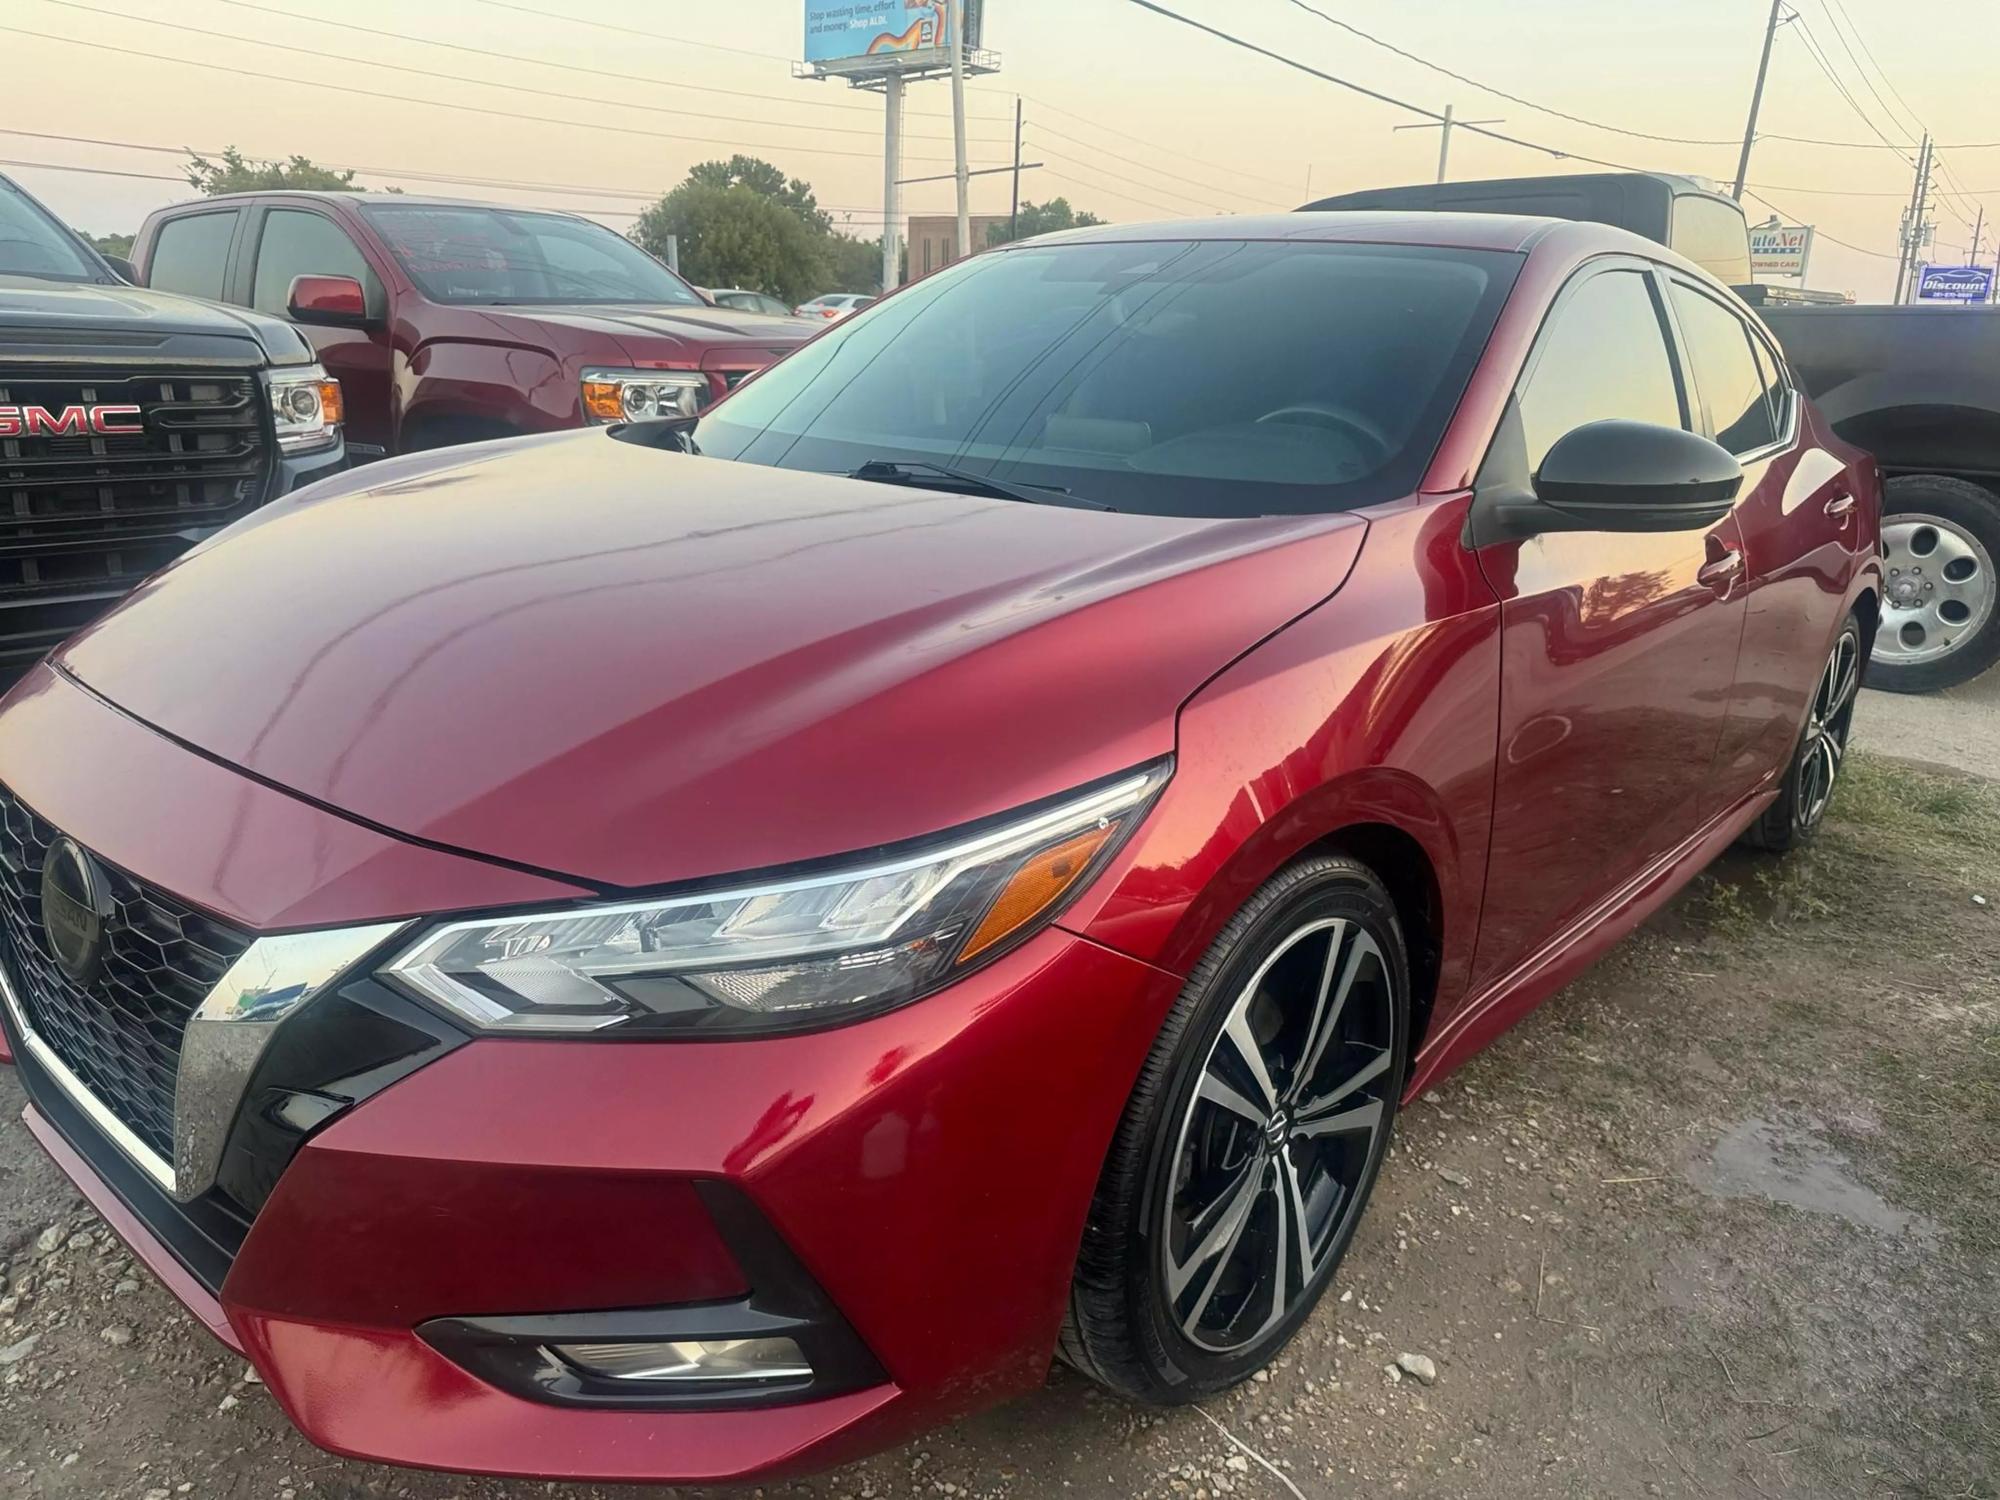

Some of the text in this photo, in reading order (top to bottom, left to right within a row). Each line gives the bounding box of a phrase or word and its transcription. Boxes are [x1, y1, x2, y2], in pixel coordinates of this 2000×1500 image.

[810, 0, 896, 21] Stop wasting time, effort
[810, 23, 822, 34] and
[849, 19, 868, 30] Shop
